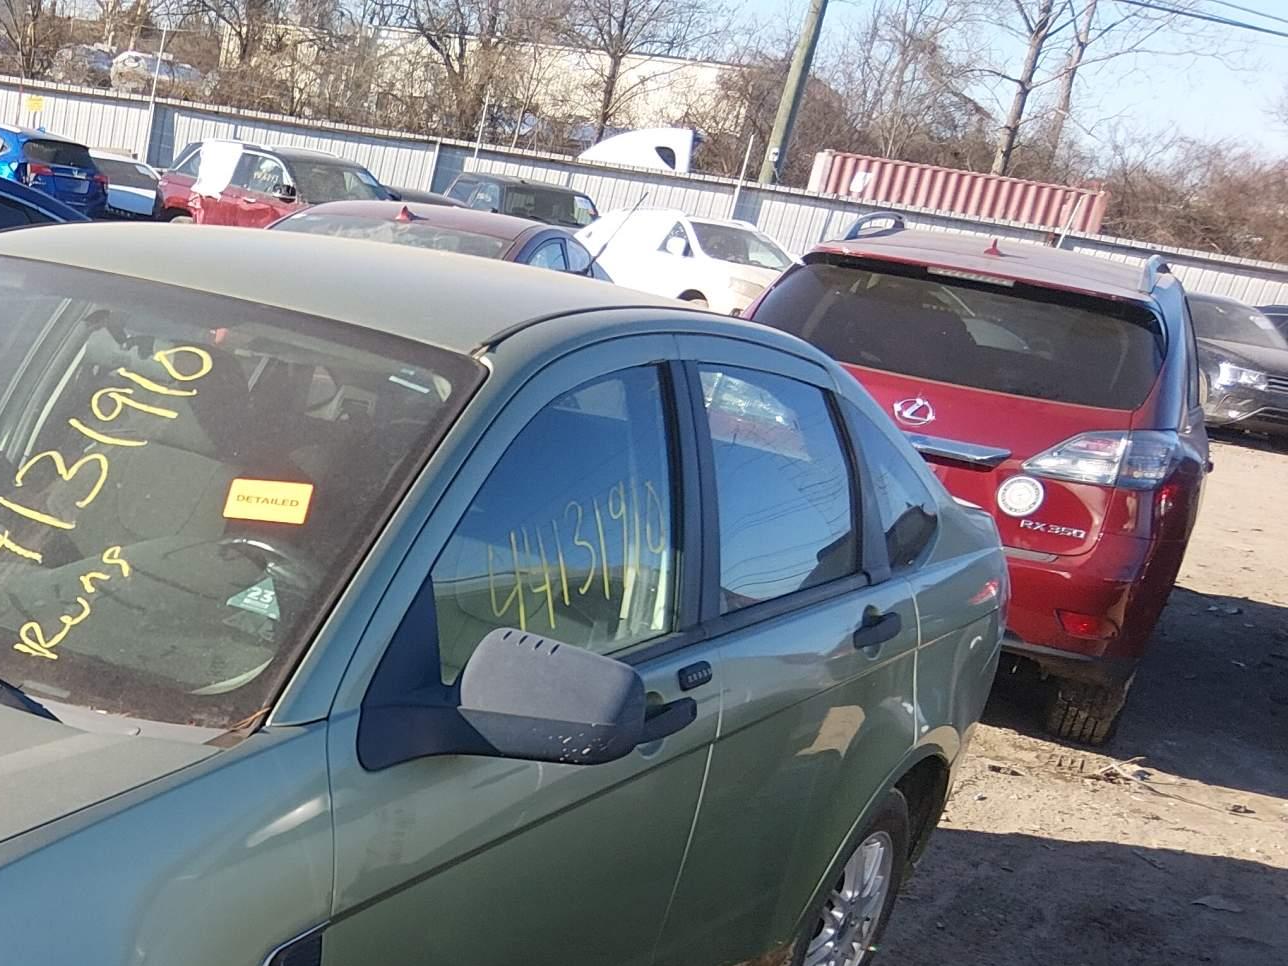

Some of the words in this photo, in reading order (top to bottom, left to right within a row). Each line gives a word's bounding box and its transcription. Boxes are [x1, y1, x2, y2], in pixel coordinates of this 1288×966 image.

[236, 494, 300, 508] DETAILED
[488, 480, 666, 632] 44131910
[246, 585, 275, 604] 23
